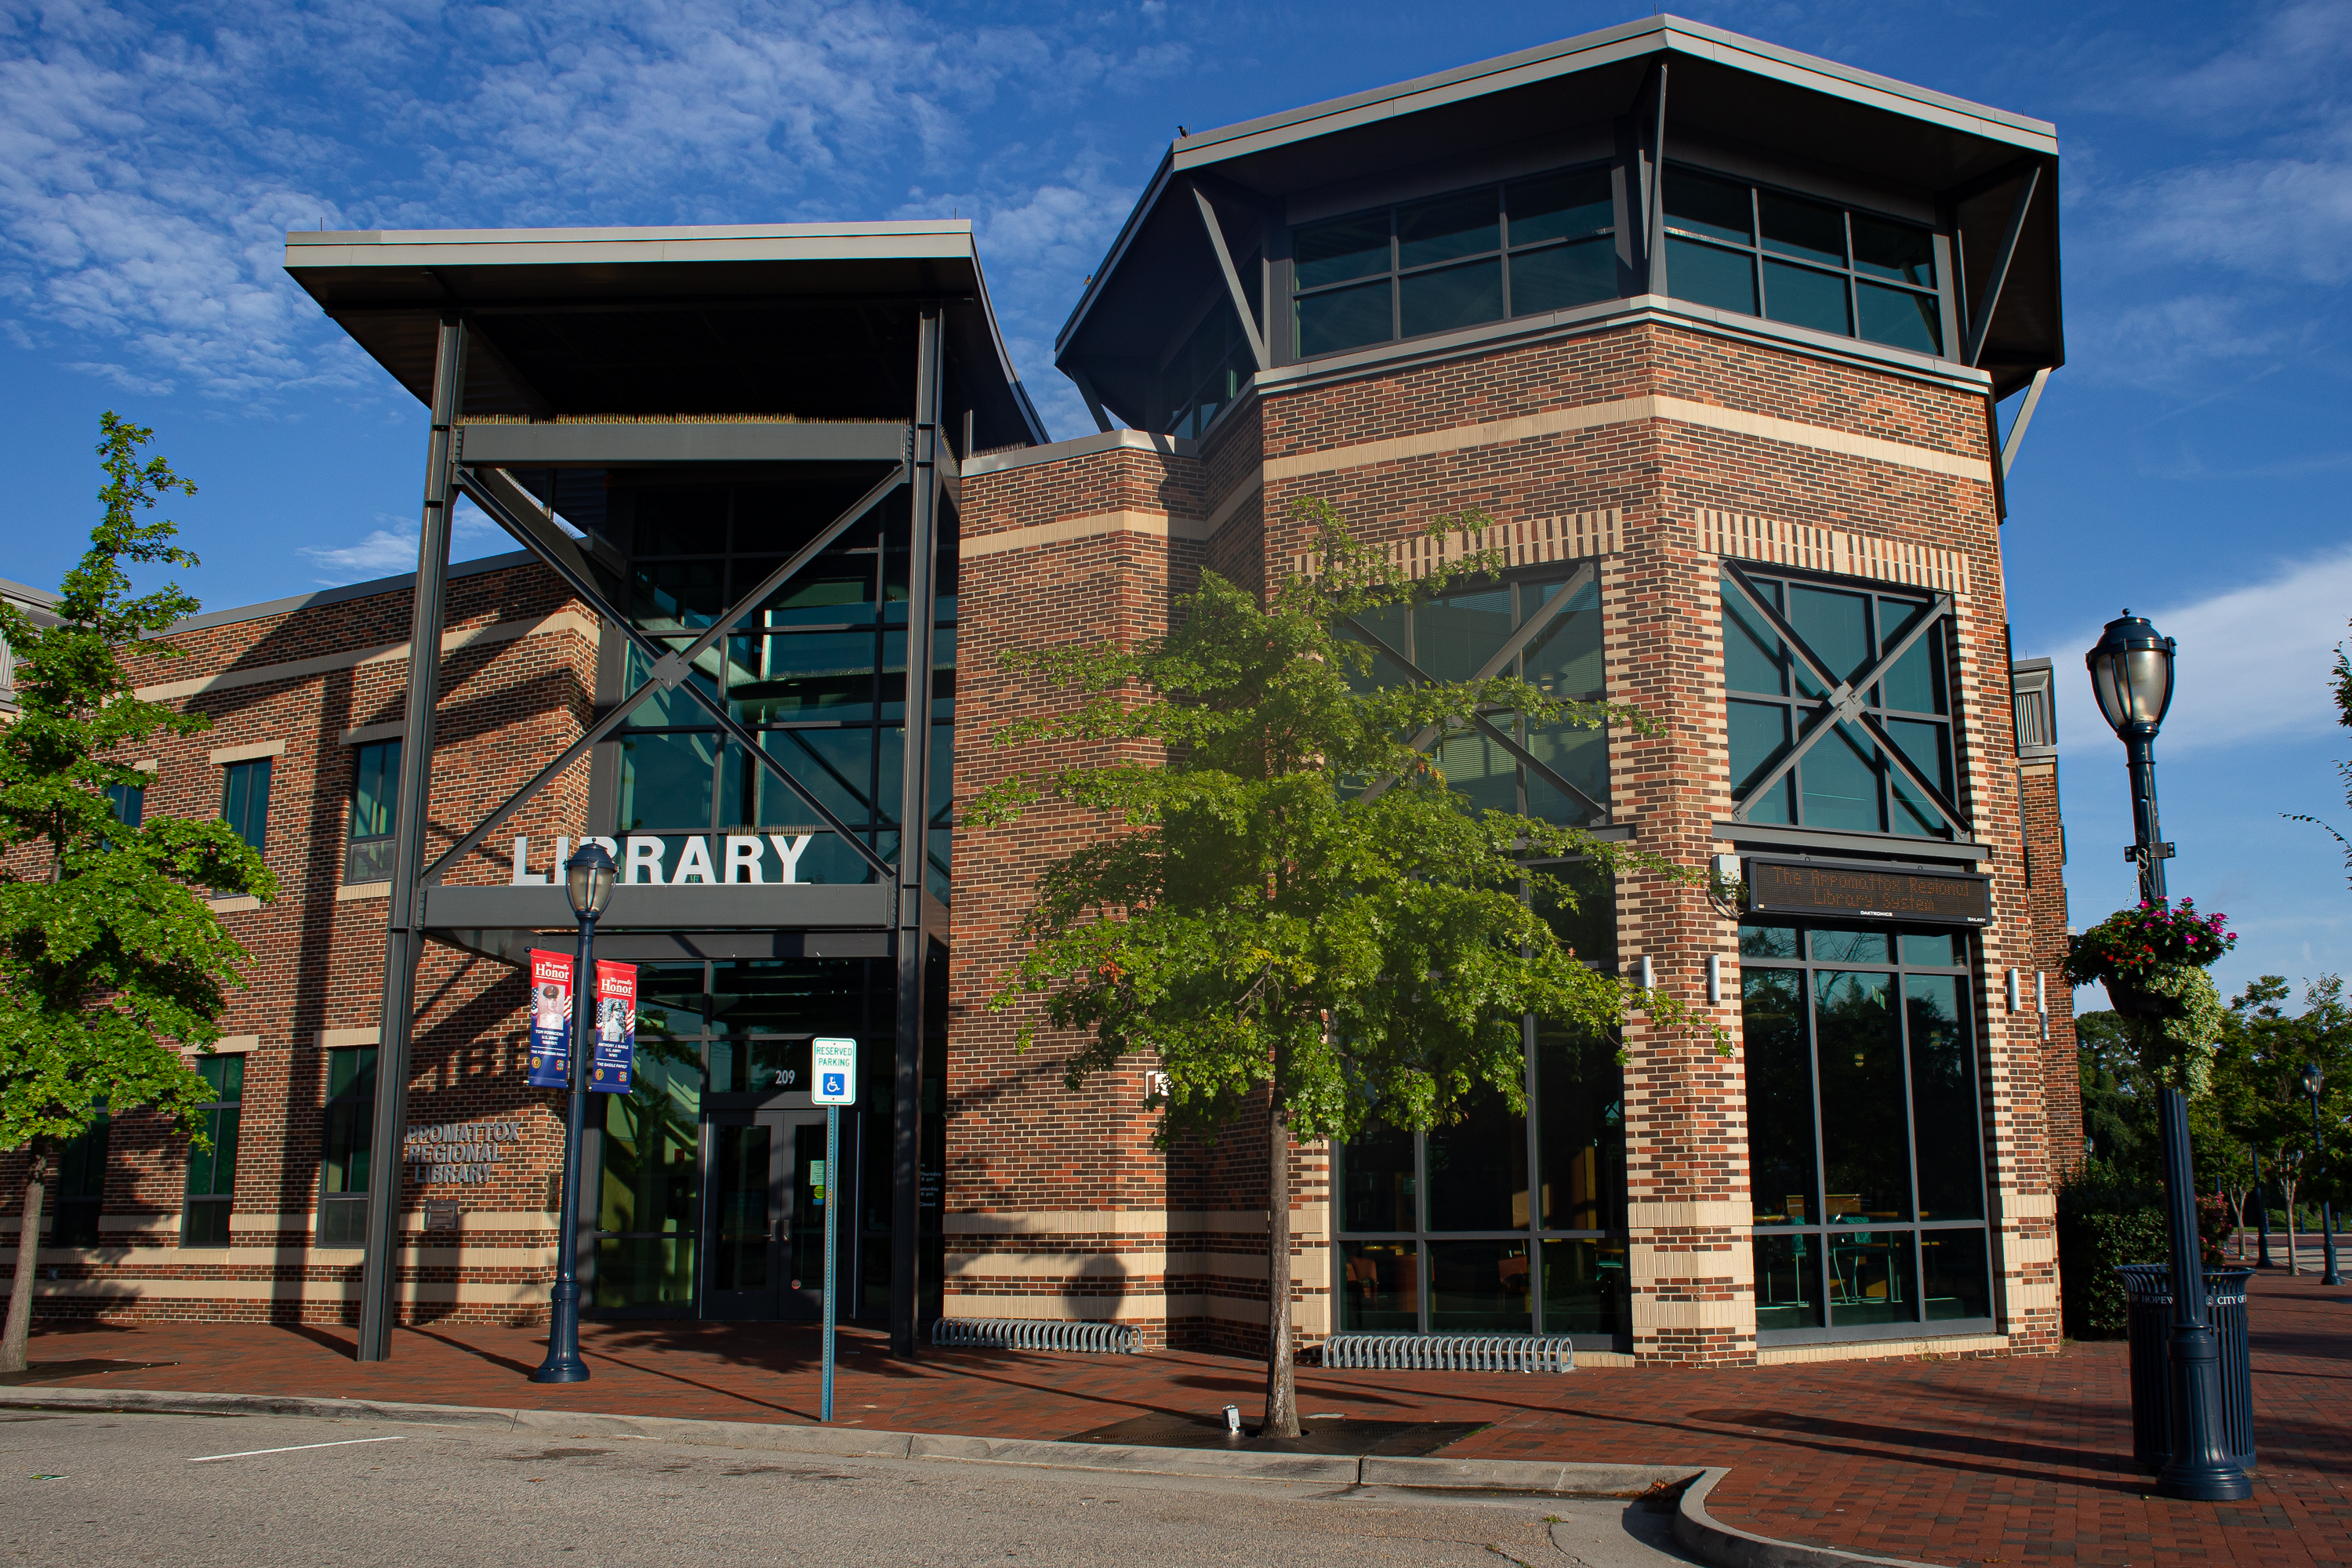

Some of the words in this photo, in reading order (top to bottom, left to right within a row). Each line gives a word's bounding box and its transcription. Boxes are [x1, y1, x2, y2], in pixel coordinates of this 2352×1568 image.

[1773, 866, 1802, 884] The
[1909, 877, 1969, 896] Regional
[1814, 887, 1873, 907] Library
[1882, 892, 1934, 911] System
[535, 963, 570, 979] Honor
[601, 978, 633, 994] Honor
[816, 1046, 852, 1056] RESERVED
[818, 1058, 850, 1067] PARKING
[775, 1070, 795, 1084] 209
[404, 1122, 521, 1144] PPOMATTOX
[408, 1143, 503, 1163] REGIONAL
[415, 1163, 493, 1183] LIBRARY
[2131, 1294, 2139, 1302] OF
[2217, 1295, 2237, 1305] CITY
